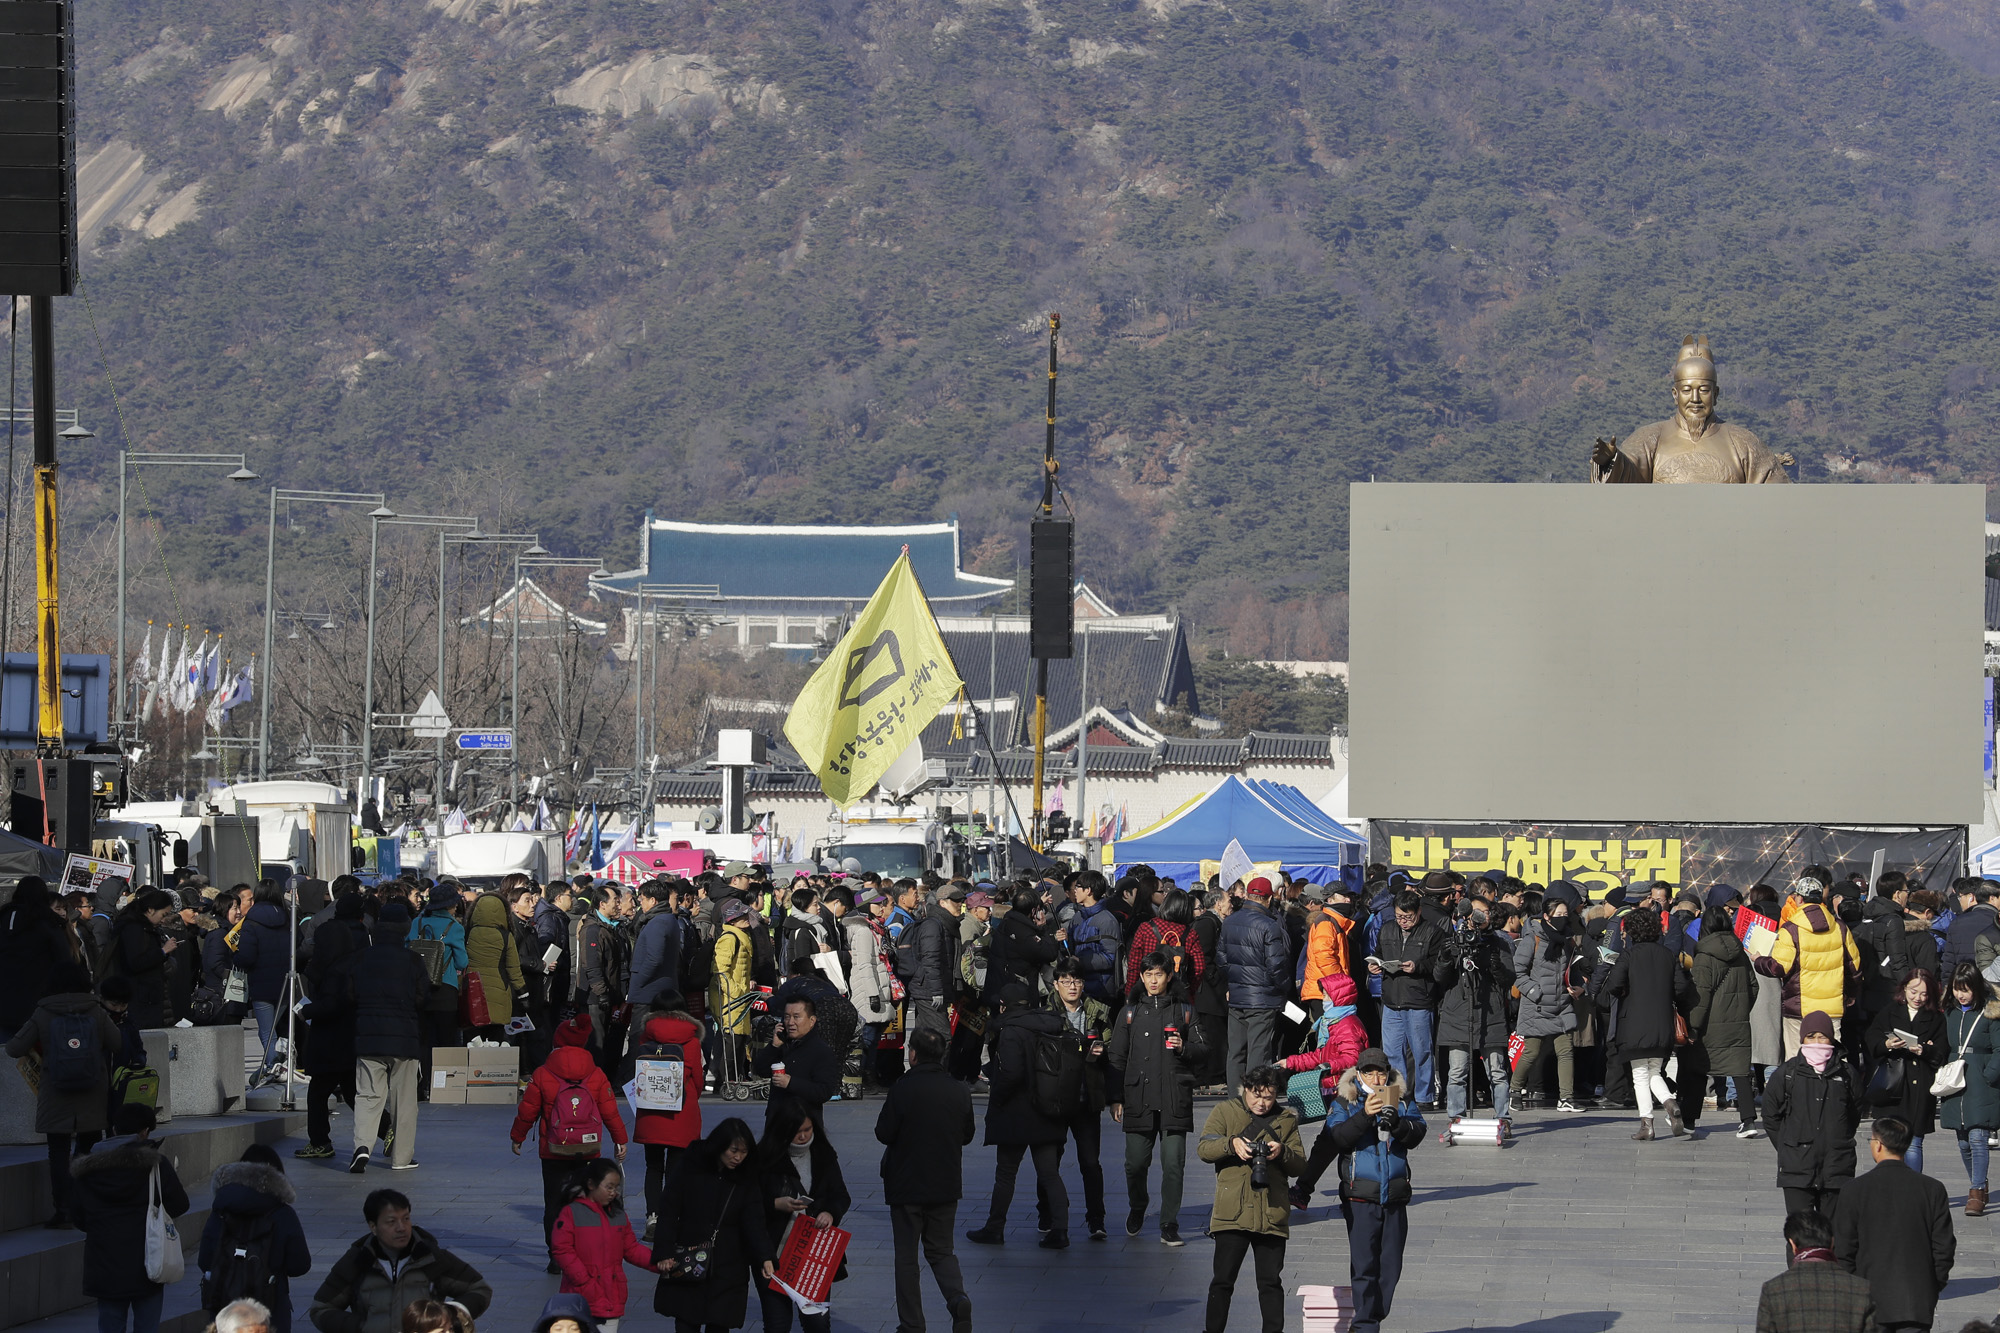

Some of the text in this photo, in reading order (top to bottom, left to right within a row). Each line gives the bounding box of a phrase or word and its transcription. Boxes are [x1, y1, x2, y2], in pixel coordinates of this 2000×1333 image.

[647, 1074, 672, 1085] 박근혜
[650, 1084, 670, 1094] 구속!
[782, 1254, 802, 1285] 권자의
